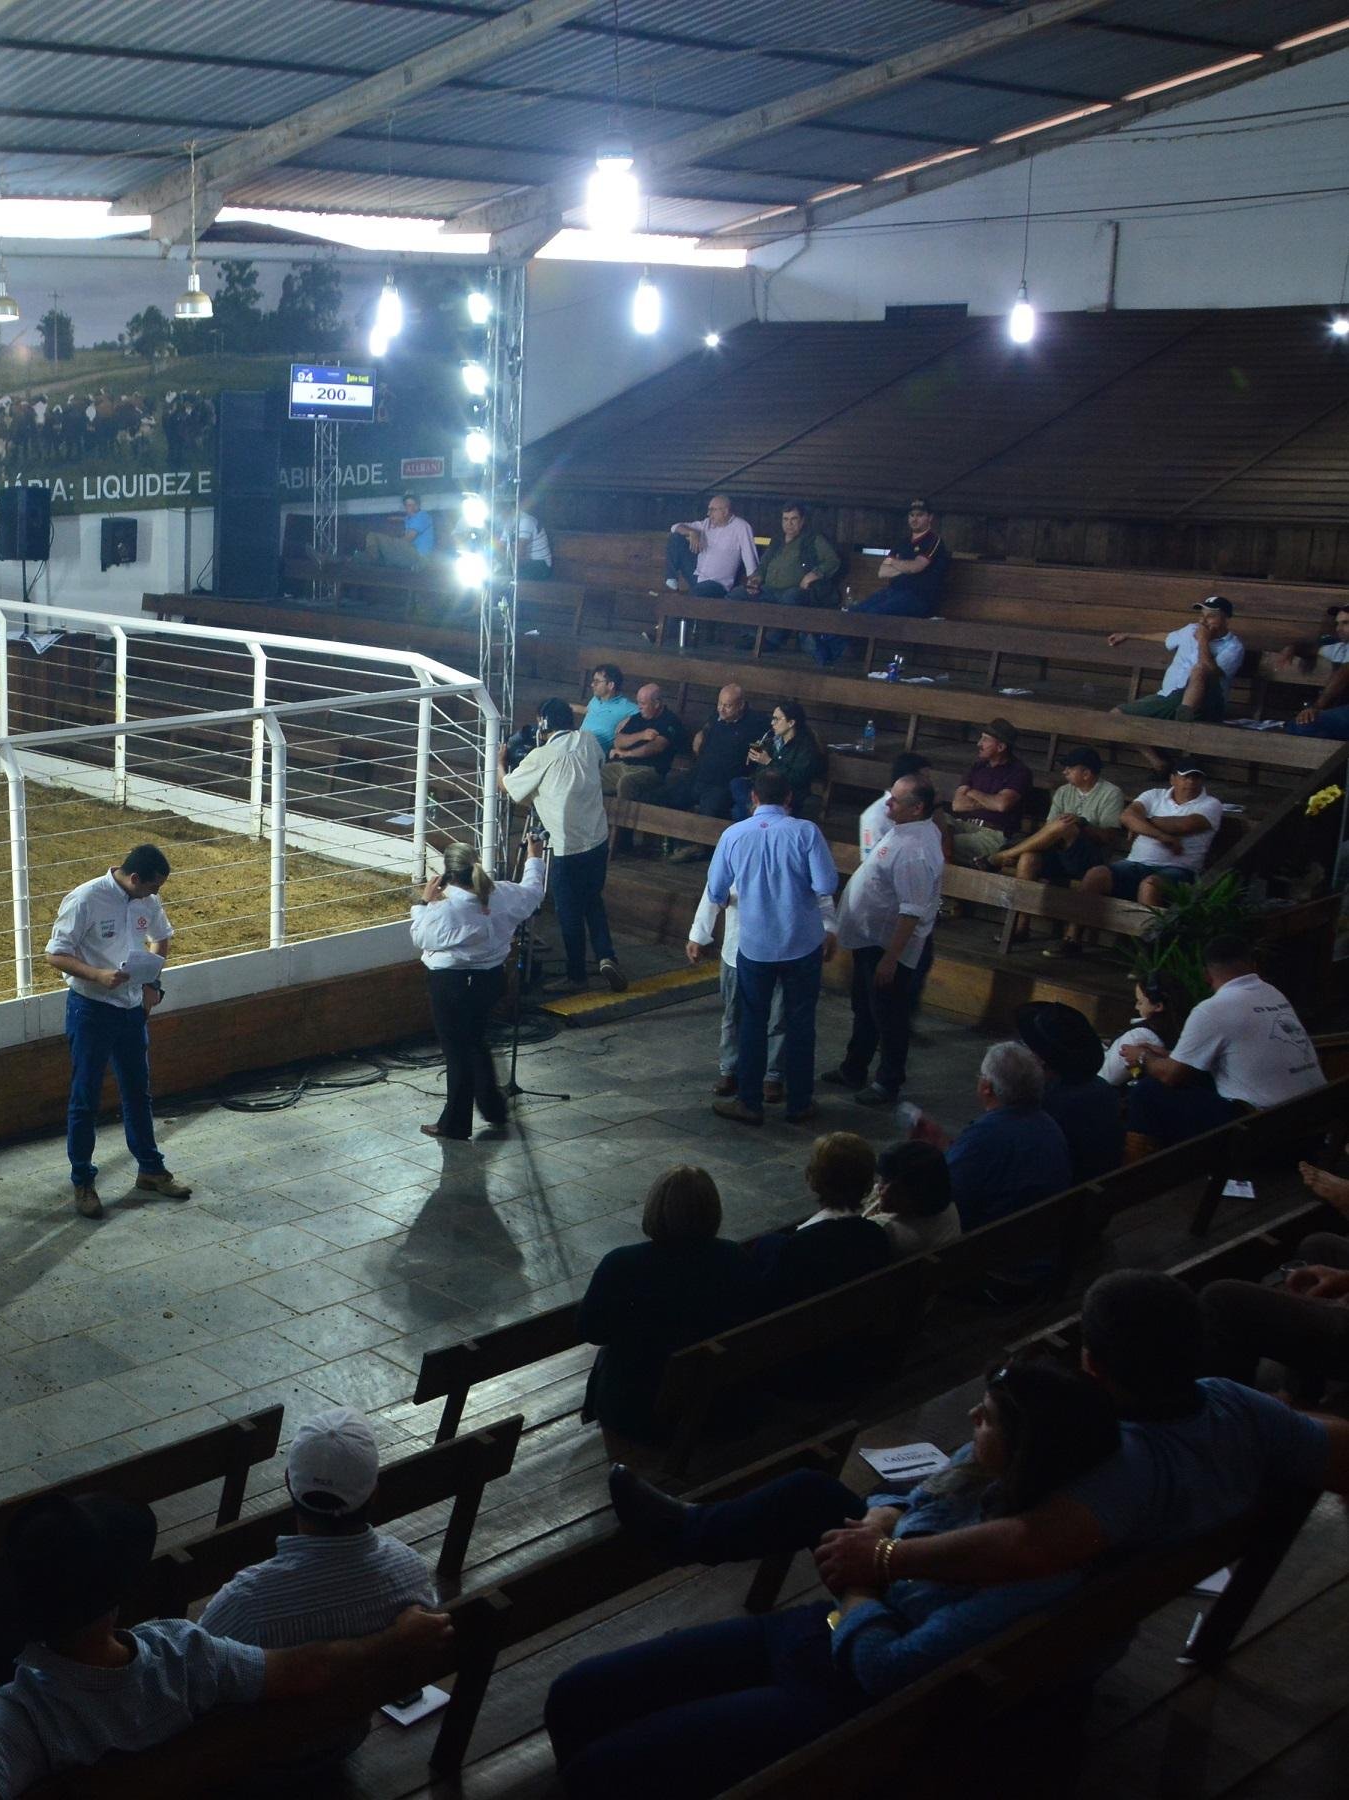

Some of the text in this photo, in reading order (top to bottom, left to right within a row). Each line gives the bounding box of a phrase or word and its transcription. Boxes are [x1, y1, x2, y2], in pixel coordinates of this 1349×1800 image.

[297, 371, 314, 383] 94
[317, 387, 347, 401] 200
[83, 472, 190, 500] LIQUIDEZ
[198, 471, 211, 493] E
